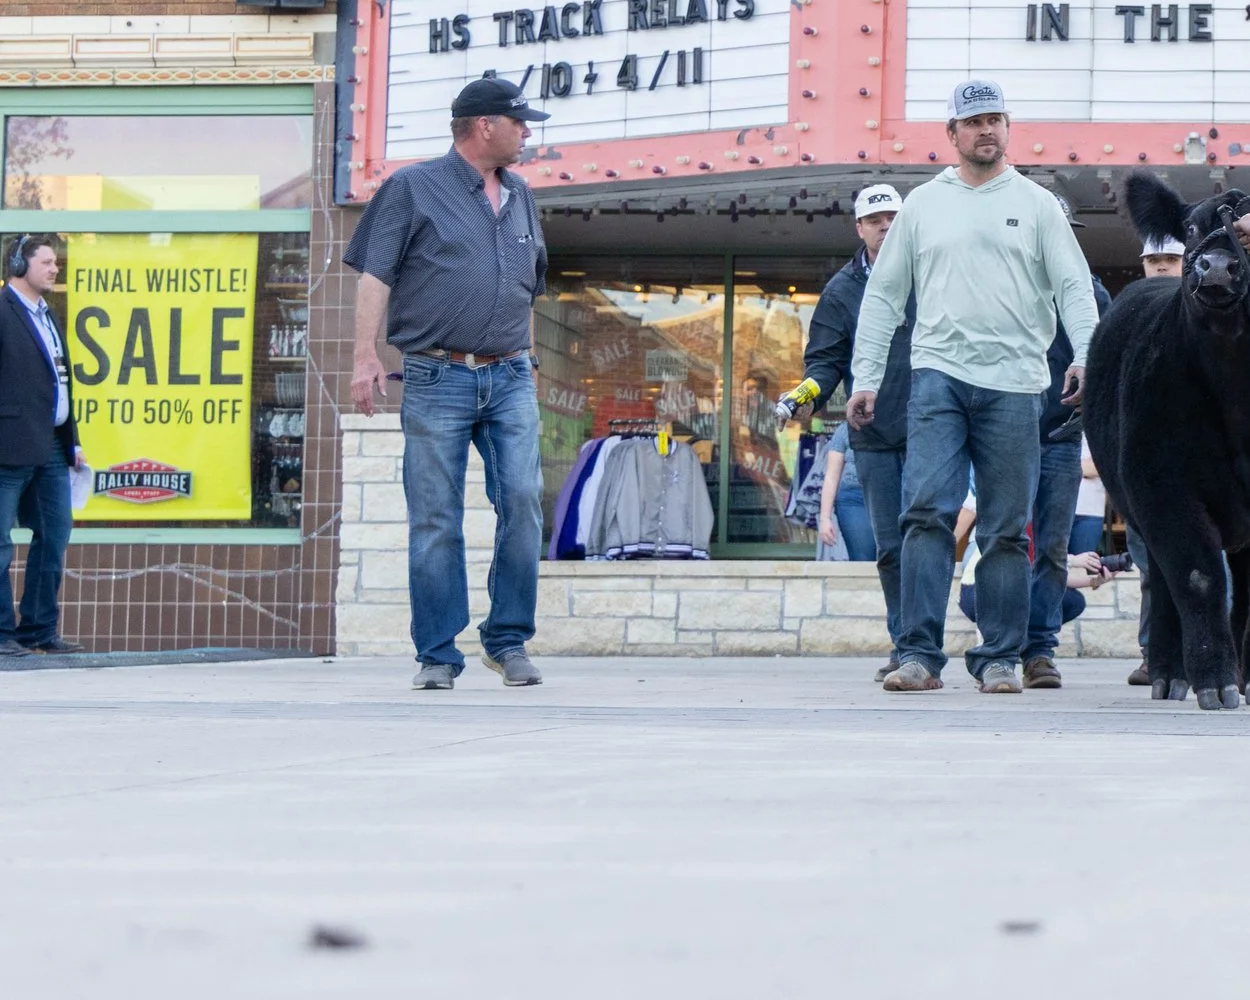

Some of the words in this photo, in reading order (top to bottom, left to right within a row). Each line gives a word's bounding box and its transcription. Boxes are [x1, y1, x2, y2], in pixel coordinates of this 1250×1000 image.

[429, 14, 472, 54] HS
[1026, 3, 1070, 42] IN
[1115, 3, 1213, 43] THE
[482, 62, 573, 99] /10
[75, 268, 136, 292] FINAL
[146, 268, 248, 293] WHISTLE!
[73, 306, 246, 386] SALE
[549, 387, 587, 412] SALE
[615, 388, 641, 401] SALE
[107, 399, 134, 424] TO
[143, 399, 193, 424] 50%
[203, 399, 243, 424] OFF
[98, 473, 139, 491] RALLY
[143, 474, 187, 492] HOUSE
